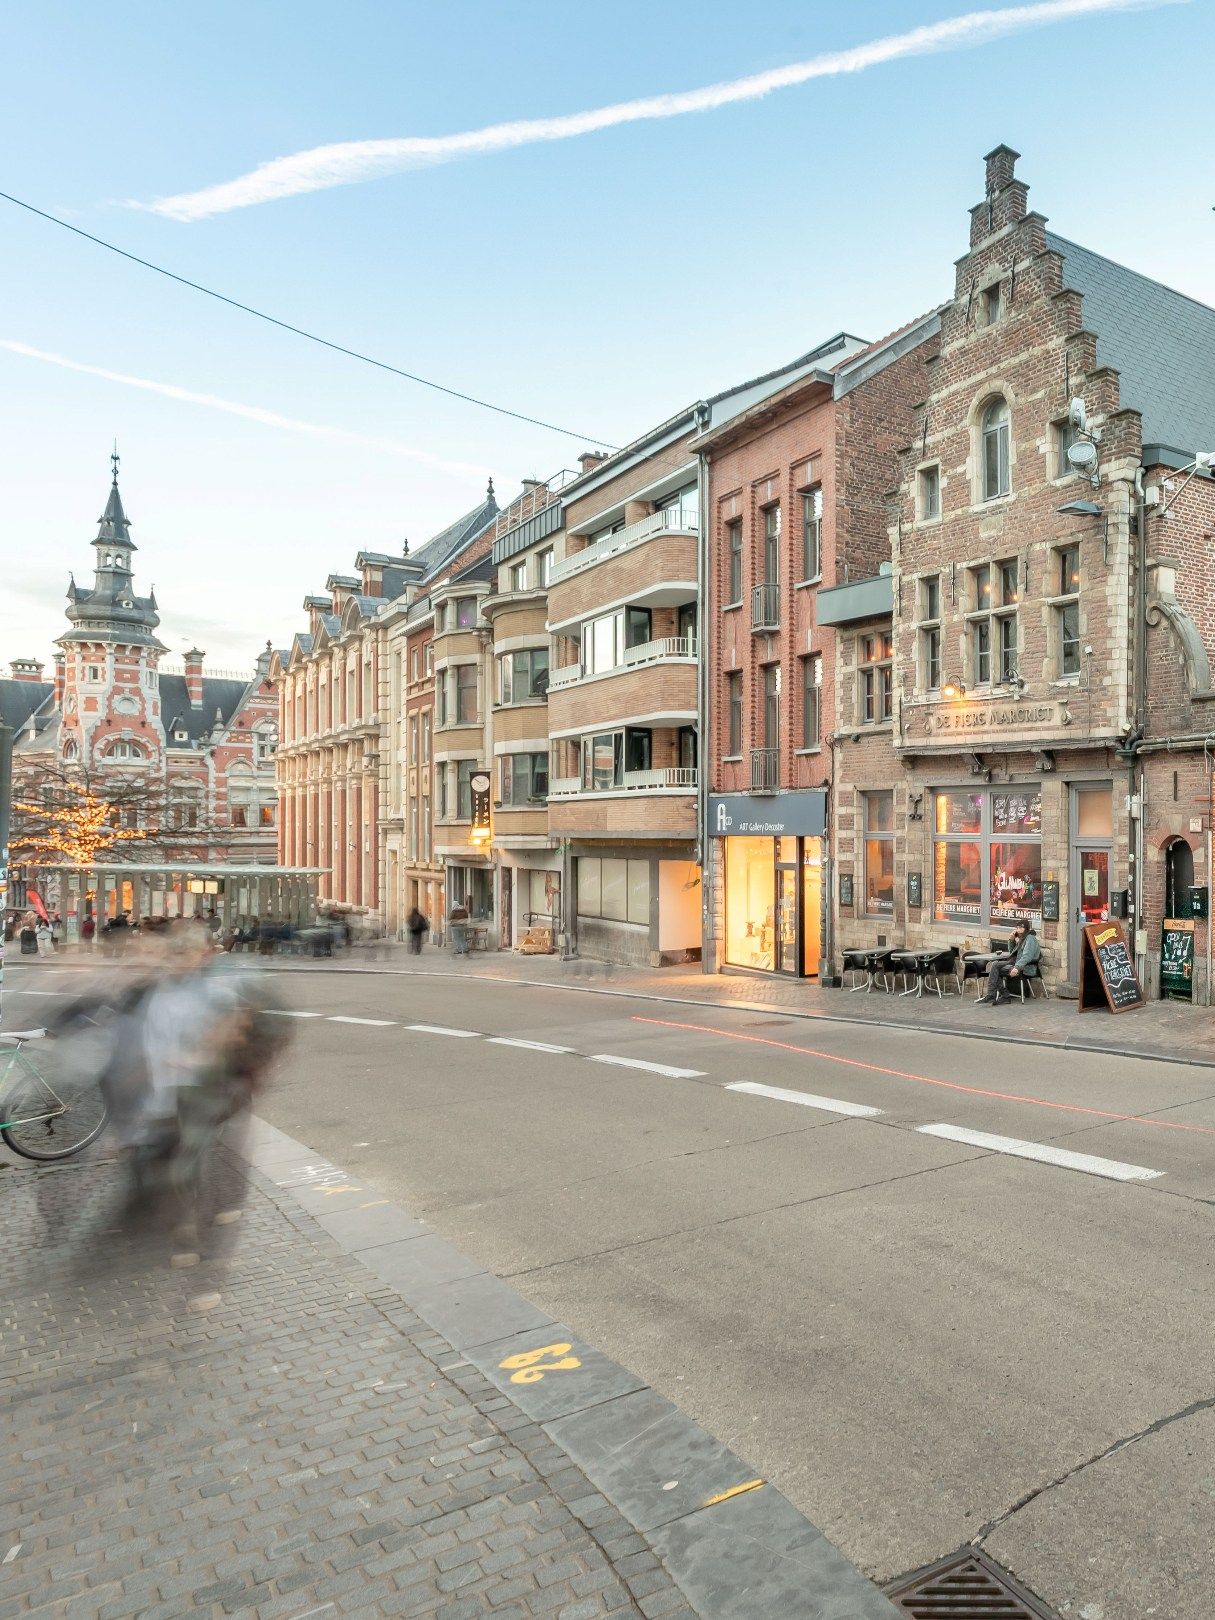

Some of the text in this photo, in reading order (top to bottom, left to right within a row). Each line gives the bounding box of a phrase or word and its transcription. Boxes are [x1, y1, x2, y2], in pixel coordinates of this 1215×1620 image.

[936, 716, 950, 729] DE
[955, 713, 986, 728] FIERE
[749, 822, 765, 833] Gallery
[957, 904, 980, 914] MARGRIET
